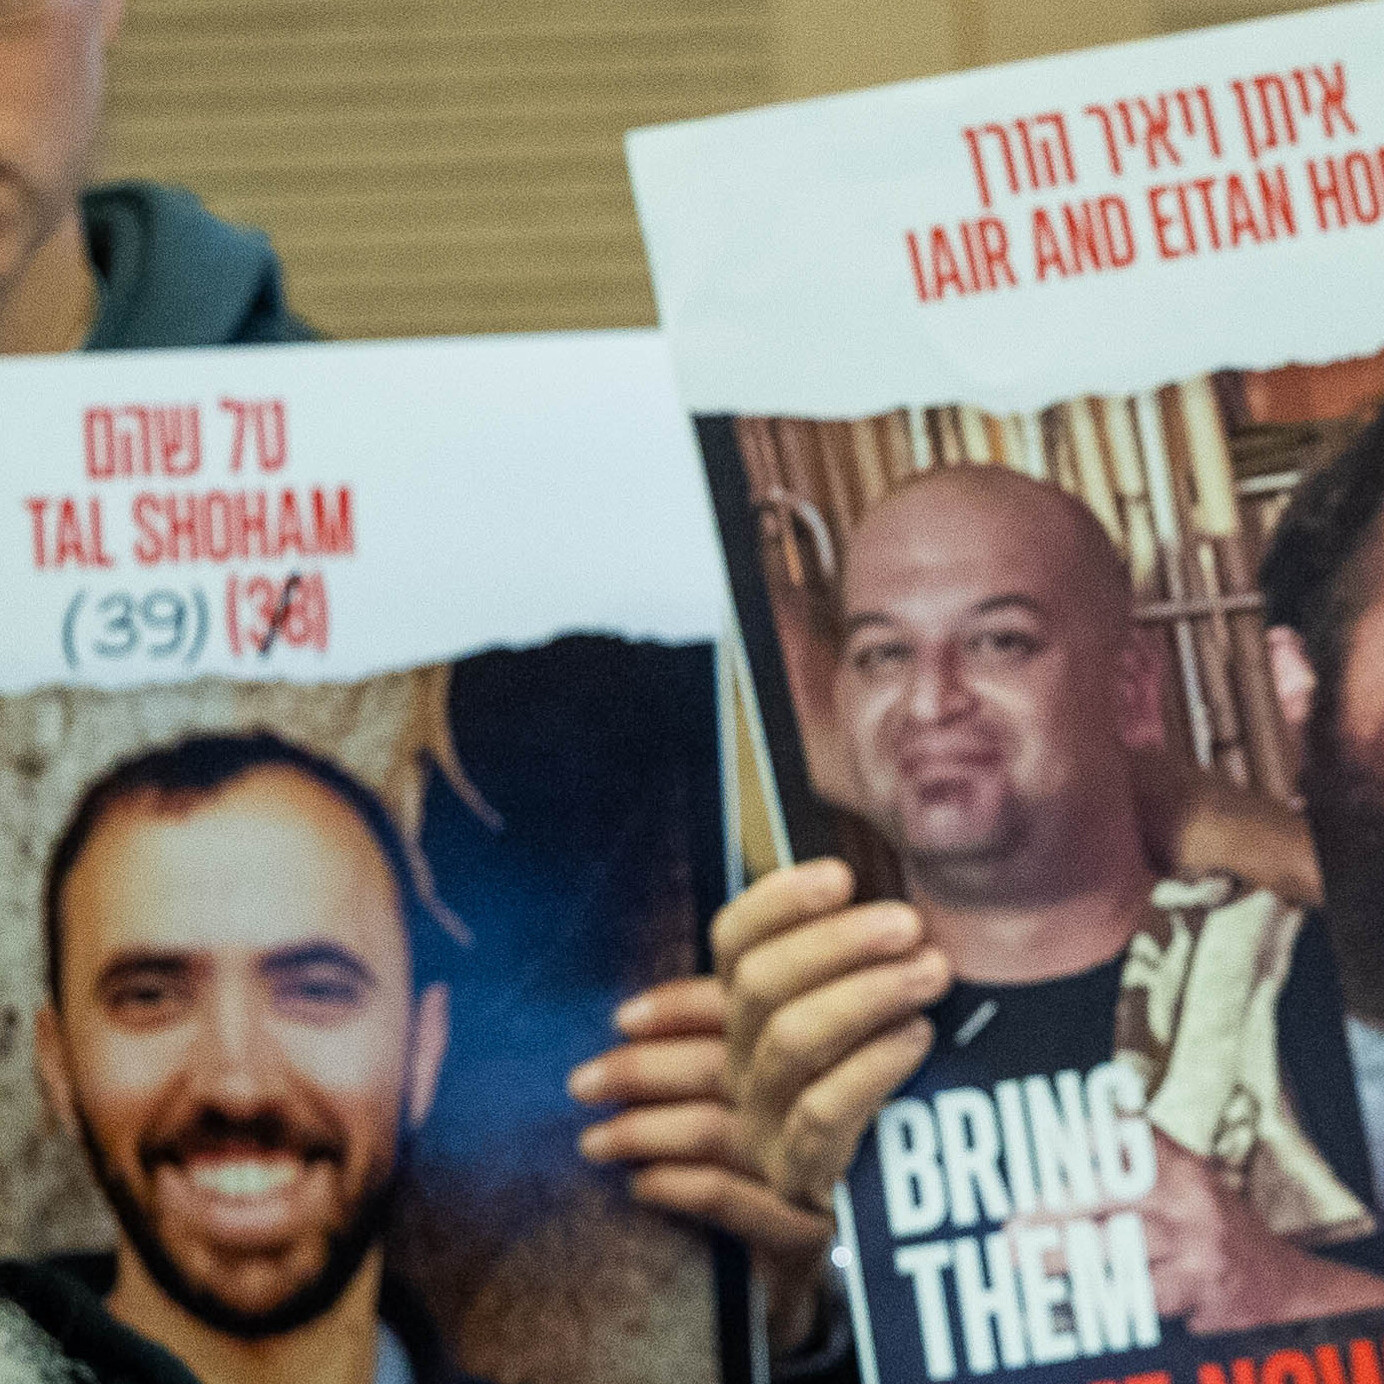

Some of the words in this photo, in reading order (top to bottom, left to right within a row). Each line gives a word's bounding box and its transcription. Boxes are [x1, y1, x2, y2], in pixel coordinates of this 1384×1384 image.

[1083, 84, 1222, 177] ויאיר
[1226, 57, 1360, 162] איתן
[961, 110, 1076, 210] הורן
[905, 214, 1018, 304] IAIR
[1031, 193, 1138, 283] AND
[1147, 161, 1298, 262] EITAN
[83, 404, 203, 482] שהם
[220, 397, 289, 474] טל
[25, 496, 115, 569] TAL
[132, 483, 355, 565] SHOHAM
[61, 587, 209, 667] (39)
[874, 1059, 1159, 1238] BRING
[893, 1210, 1161, 1381] THEM
